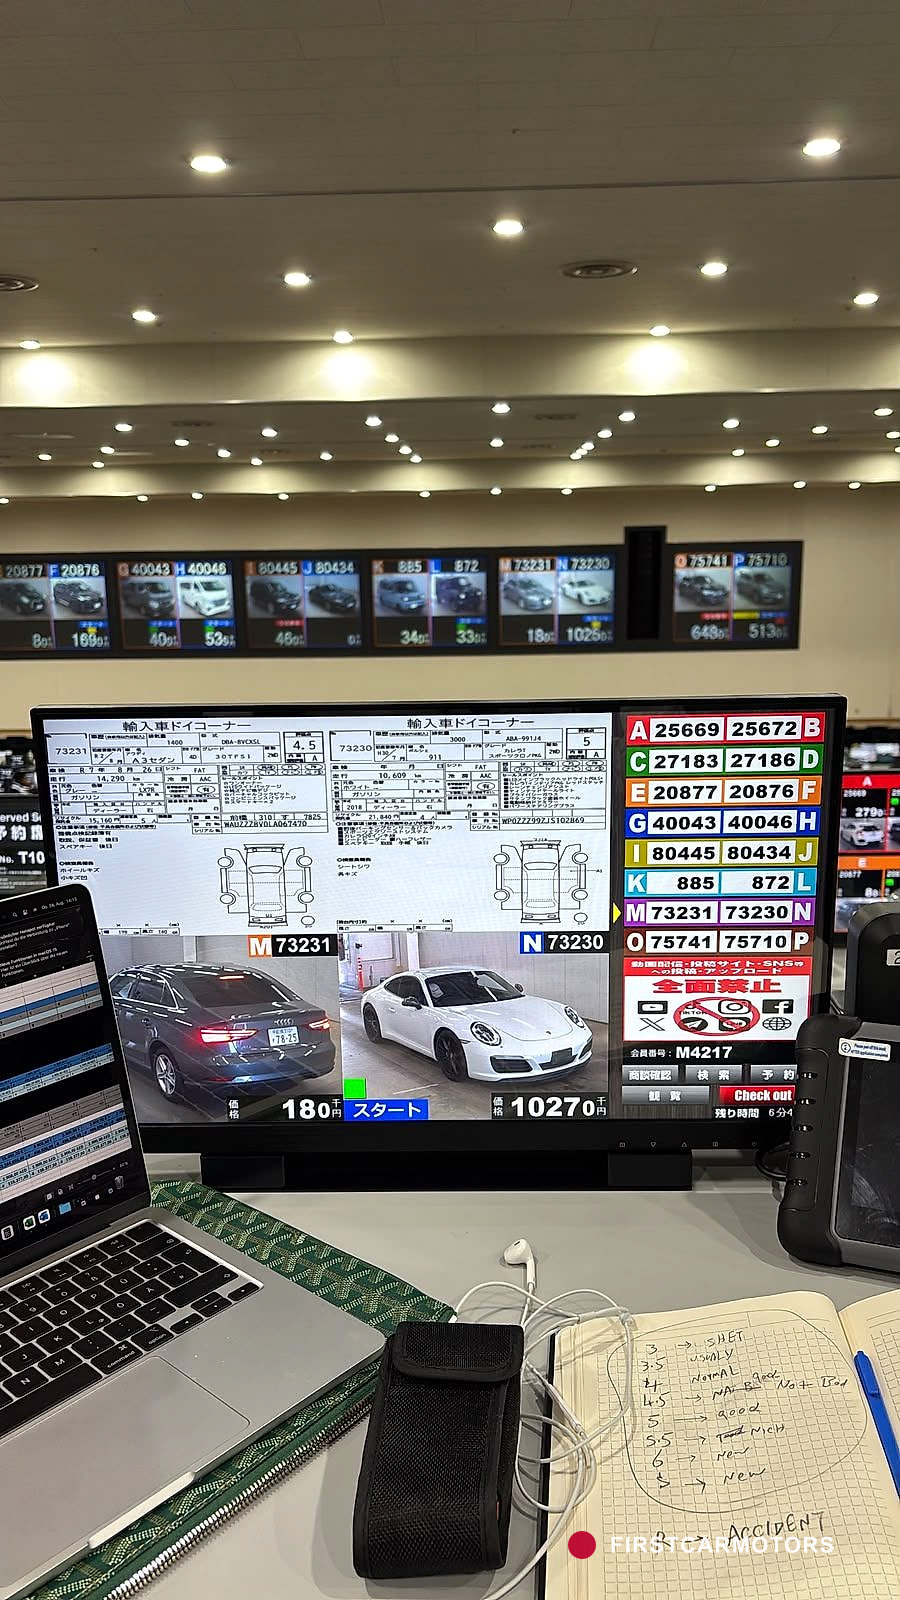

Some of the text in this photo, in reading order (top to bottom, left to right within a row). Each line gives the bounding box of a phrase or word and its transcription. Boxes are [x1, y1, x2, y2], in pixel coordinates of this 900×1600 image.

[398, 560, 422, 573] 885
[454, 560, 479, 572] 872
[514, 559, 551, 571] 73231
[570, 557, 610, 570] 73230
[688, 553, 727, 568] 75741
[61, 563, 100, 577] 20876
[131, 563, 170, 576] 40043
[175, 562, 227, 575] H 40046
[258, 561, 298, 575] 80445
[315, 561, 354, 575] 80434
[122, 721, 251, 732] 輸入車ドイコーナー
[407, 717, 534, 729] 輸入車ドイコーナー
[629, 717, 821, 740] A 25669 25672 B
[292, 740, 316, 750] 4.5
[340, 744, 372, 752] 73230
[583, 737, 591, 747] 5
[55, 747, 87, 755] 73231
[629, 750, 819, 772] C 27183 27186 D
[862, 775, 872, 787] A
[631, 780, 817, 802] E 20877 20876 F
[628, 811, 817, 833] G 40043 40046 H
[17, 850, 45, 864] T10
[633, 842, 813, 863] I 80445 80434 J
[627, 872, 812, 893] K 885 872 L
[626, 902, 812, 922] M 73231 73230 N
[249, 937, 330, 956] M 73231
[523, 934, 604, 952] N 73230
[626, 932, 809, 952] O 75741 75710 P
[652, 978, 782, 994] 全面禁止
[676, 1046, 733, 1059] M4217
[734, 1089, 793, 1101] Check out
[282, 1099, 330, 1119] 180
[353, 1102, 421, 1118] スタート
[511, 1096, 595, 1117] 10270
[714, 1108, 759, 1119] 残り時間
[646, 1344, 658, 1355] 3
[107, 1350, 135, 1368] command
[641, 1356, 667, 1371] 3.5
[643, 1391, 670, 1407] 4.5
[648, 1414, 660, 1428] 5
[652, 1449, 664, 1468] 6
